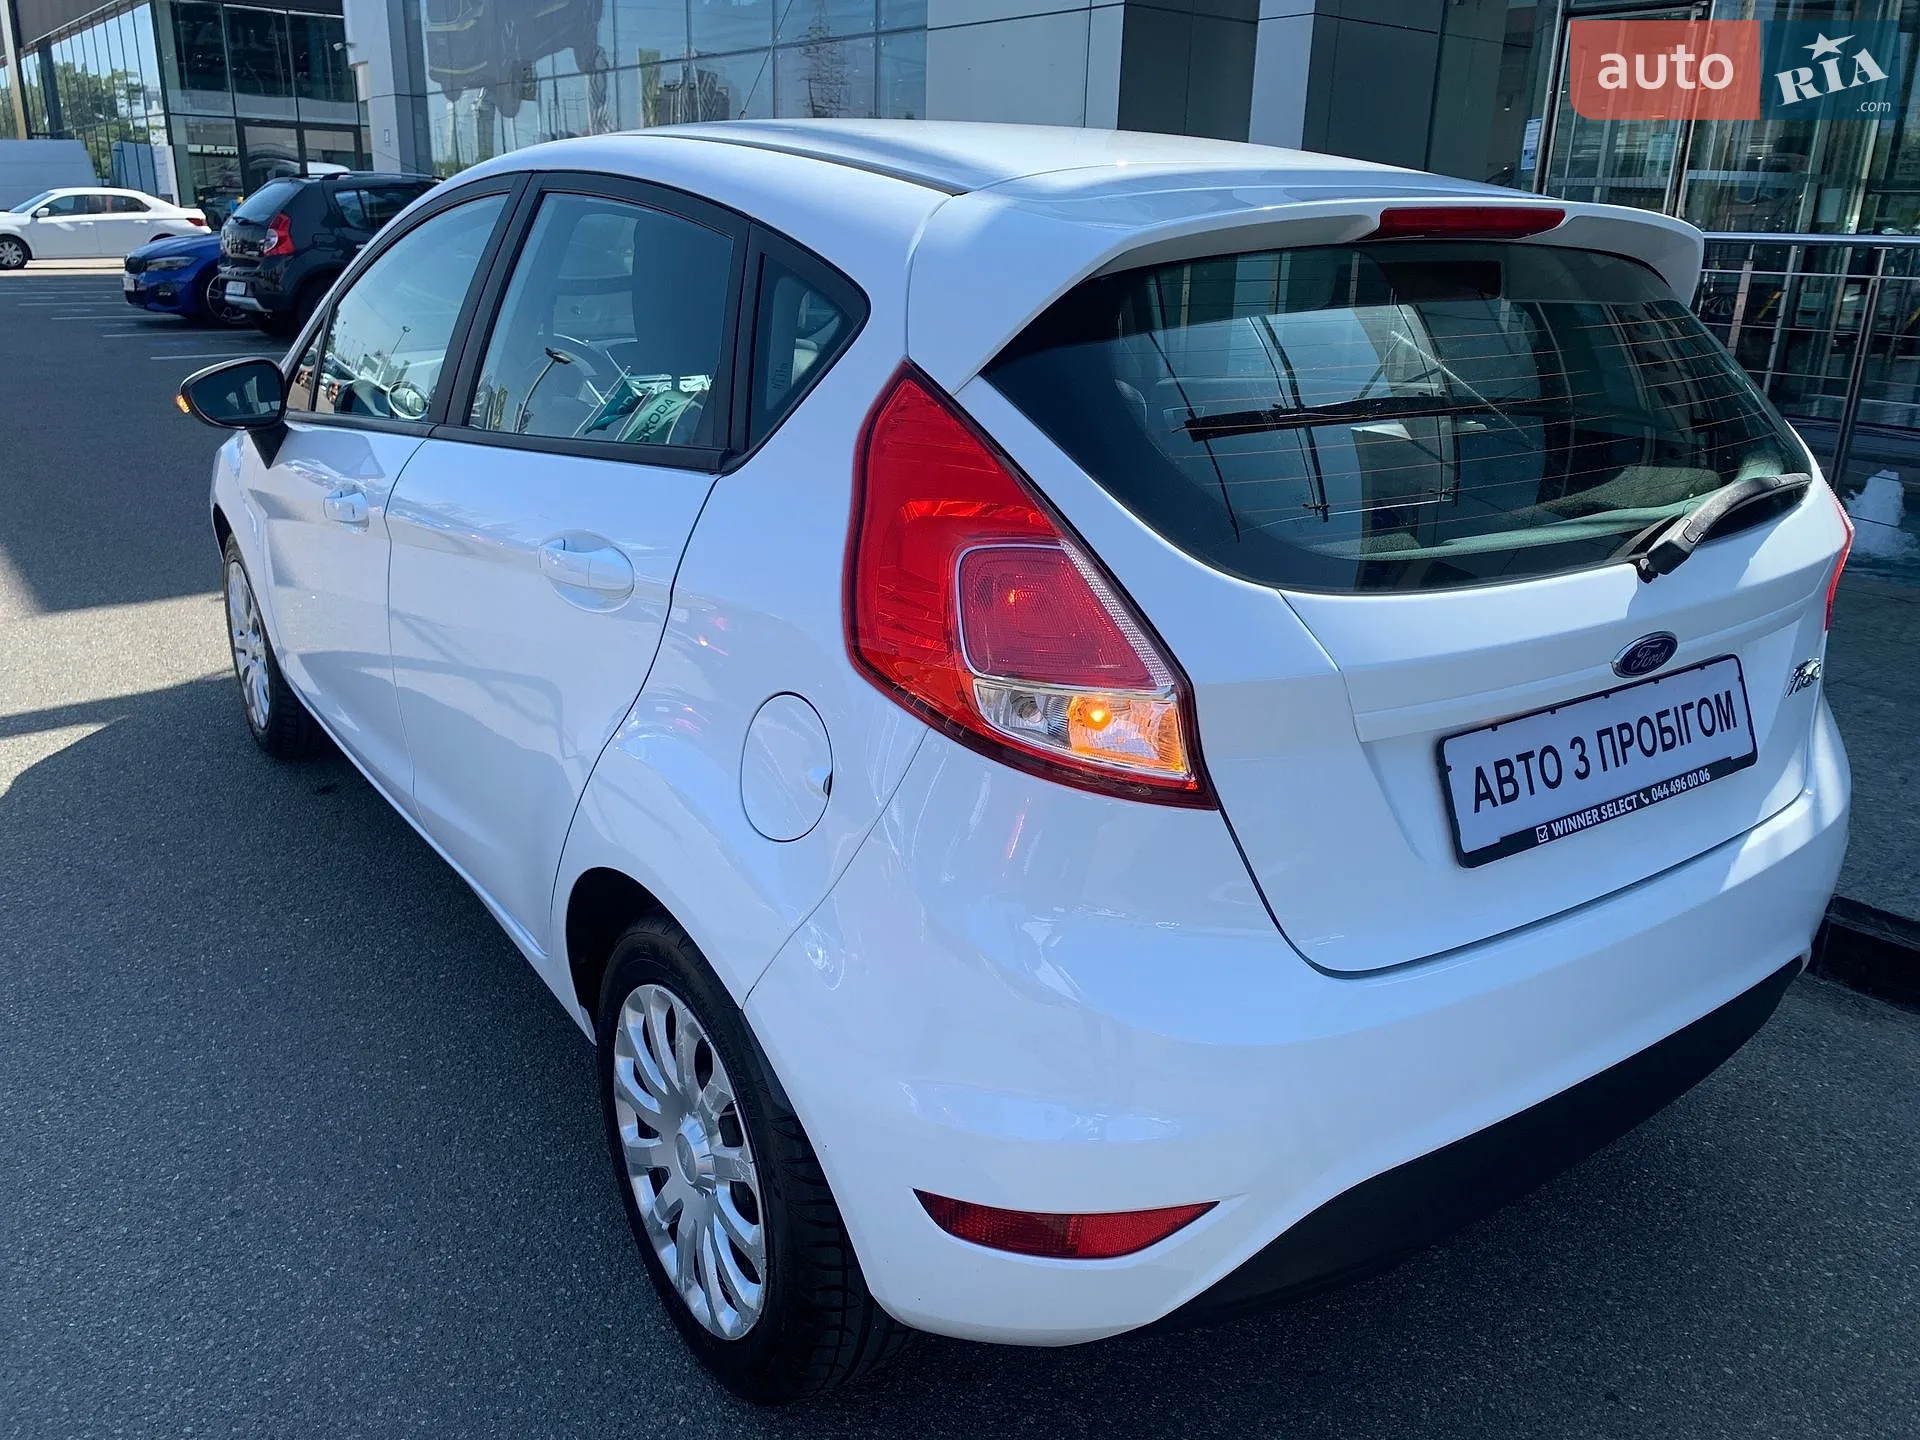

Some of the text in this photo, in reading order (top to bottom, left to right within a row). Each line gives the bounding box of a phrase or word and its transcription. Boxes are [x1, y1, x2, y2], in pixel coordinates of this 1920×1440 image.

[1630, 642, 1669, 671] Ford
[1473, 744, 1563, 814] АВТО
[1596, 690, 1738, 772] ПРОБІГОМ
[1551, 767, 1711, 837] WINNER SELECT 044 496 00 06
